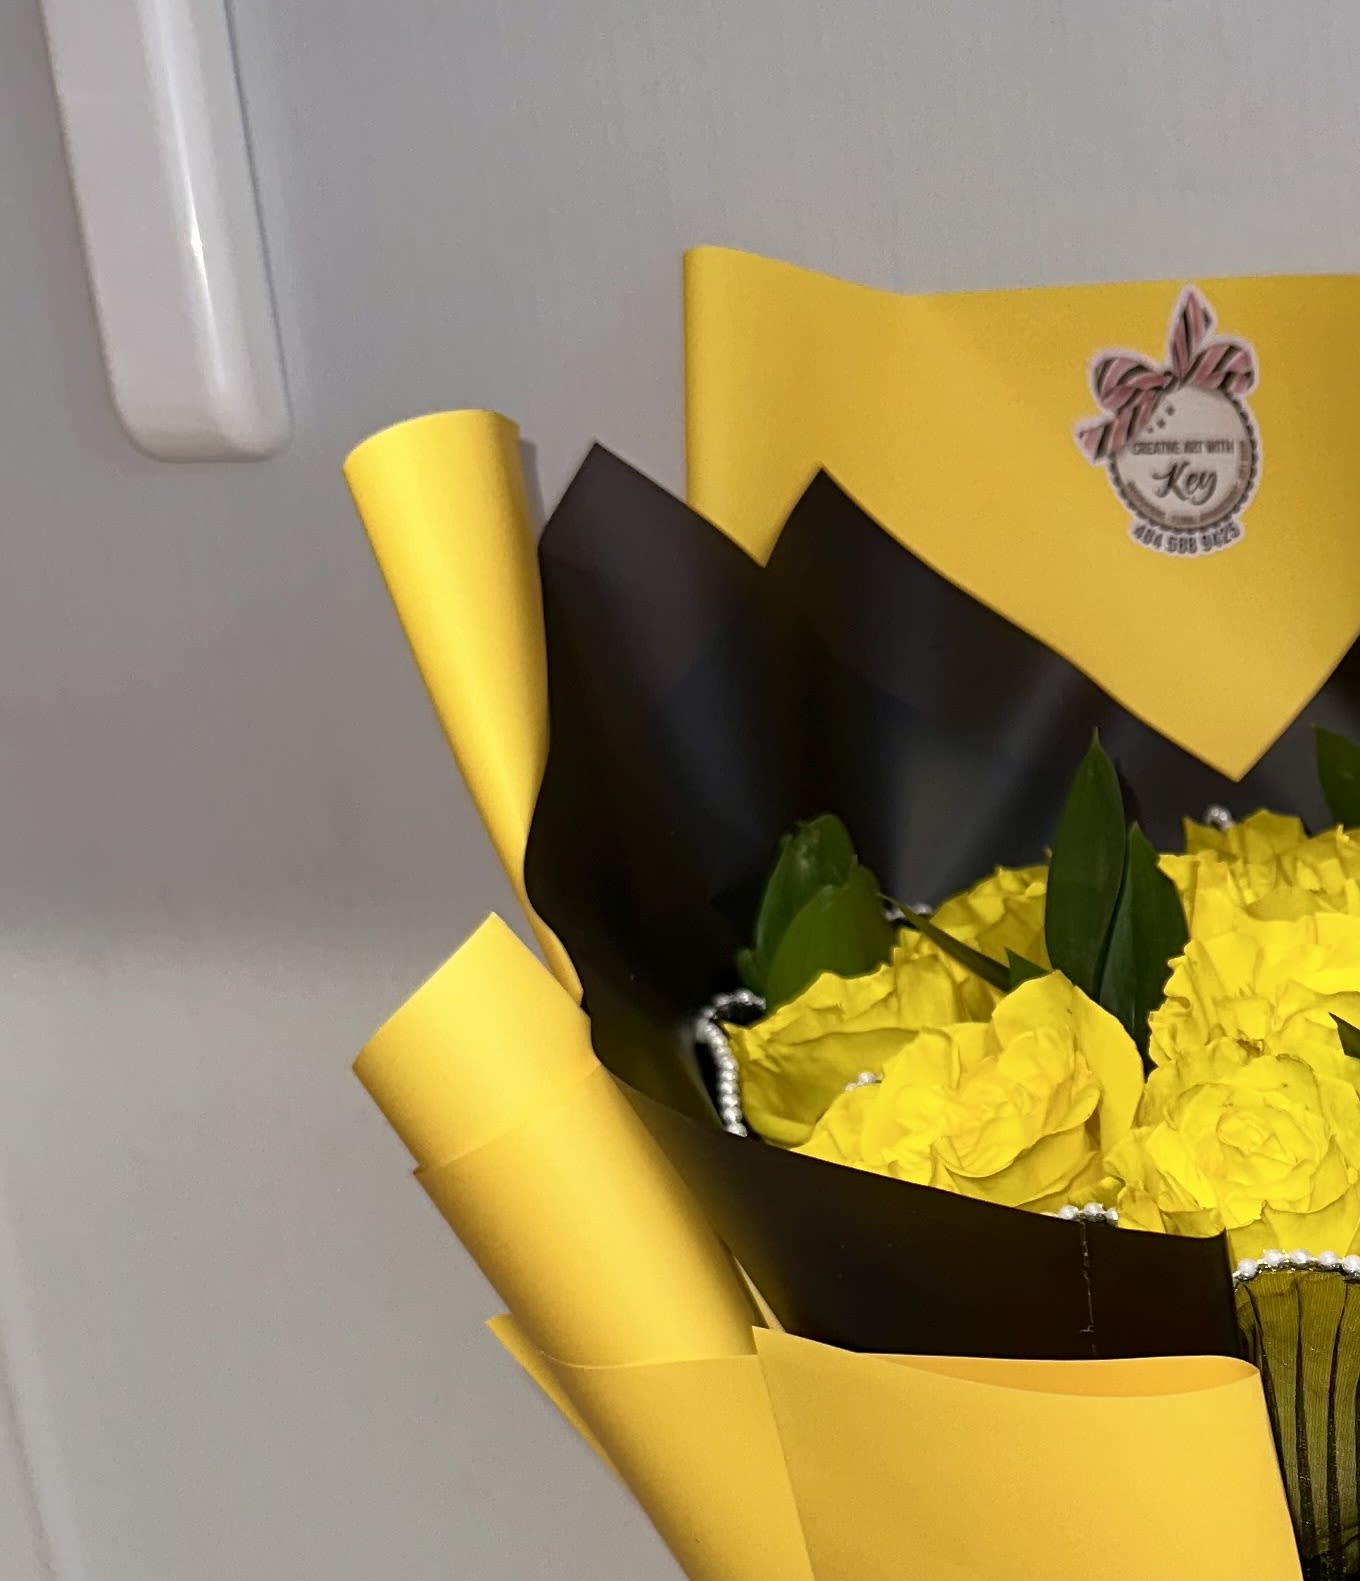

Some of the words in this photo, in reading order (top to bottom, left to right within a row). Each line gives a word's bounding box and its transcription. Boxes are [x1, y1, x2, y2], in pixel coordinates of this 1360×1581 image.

[1133, 440, 1180, 455] CREATIVE
[1183, 440, 1202, 454] ART
[1205, 440, 1235, 454] WITH
[1152, 461, 1218, 506] Key
